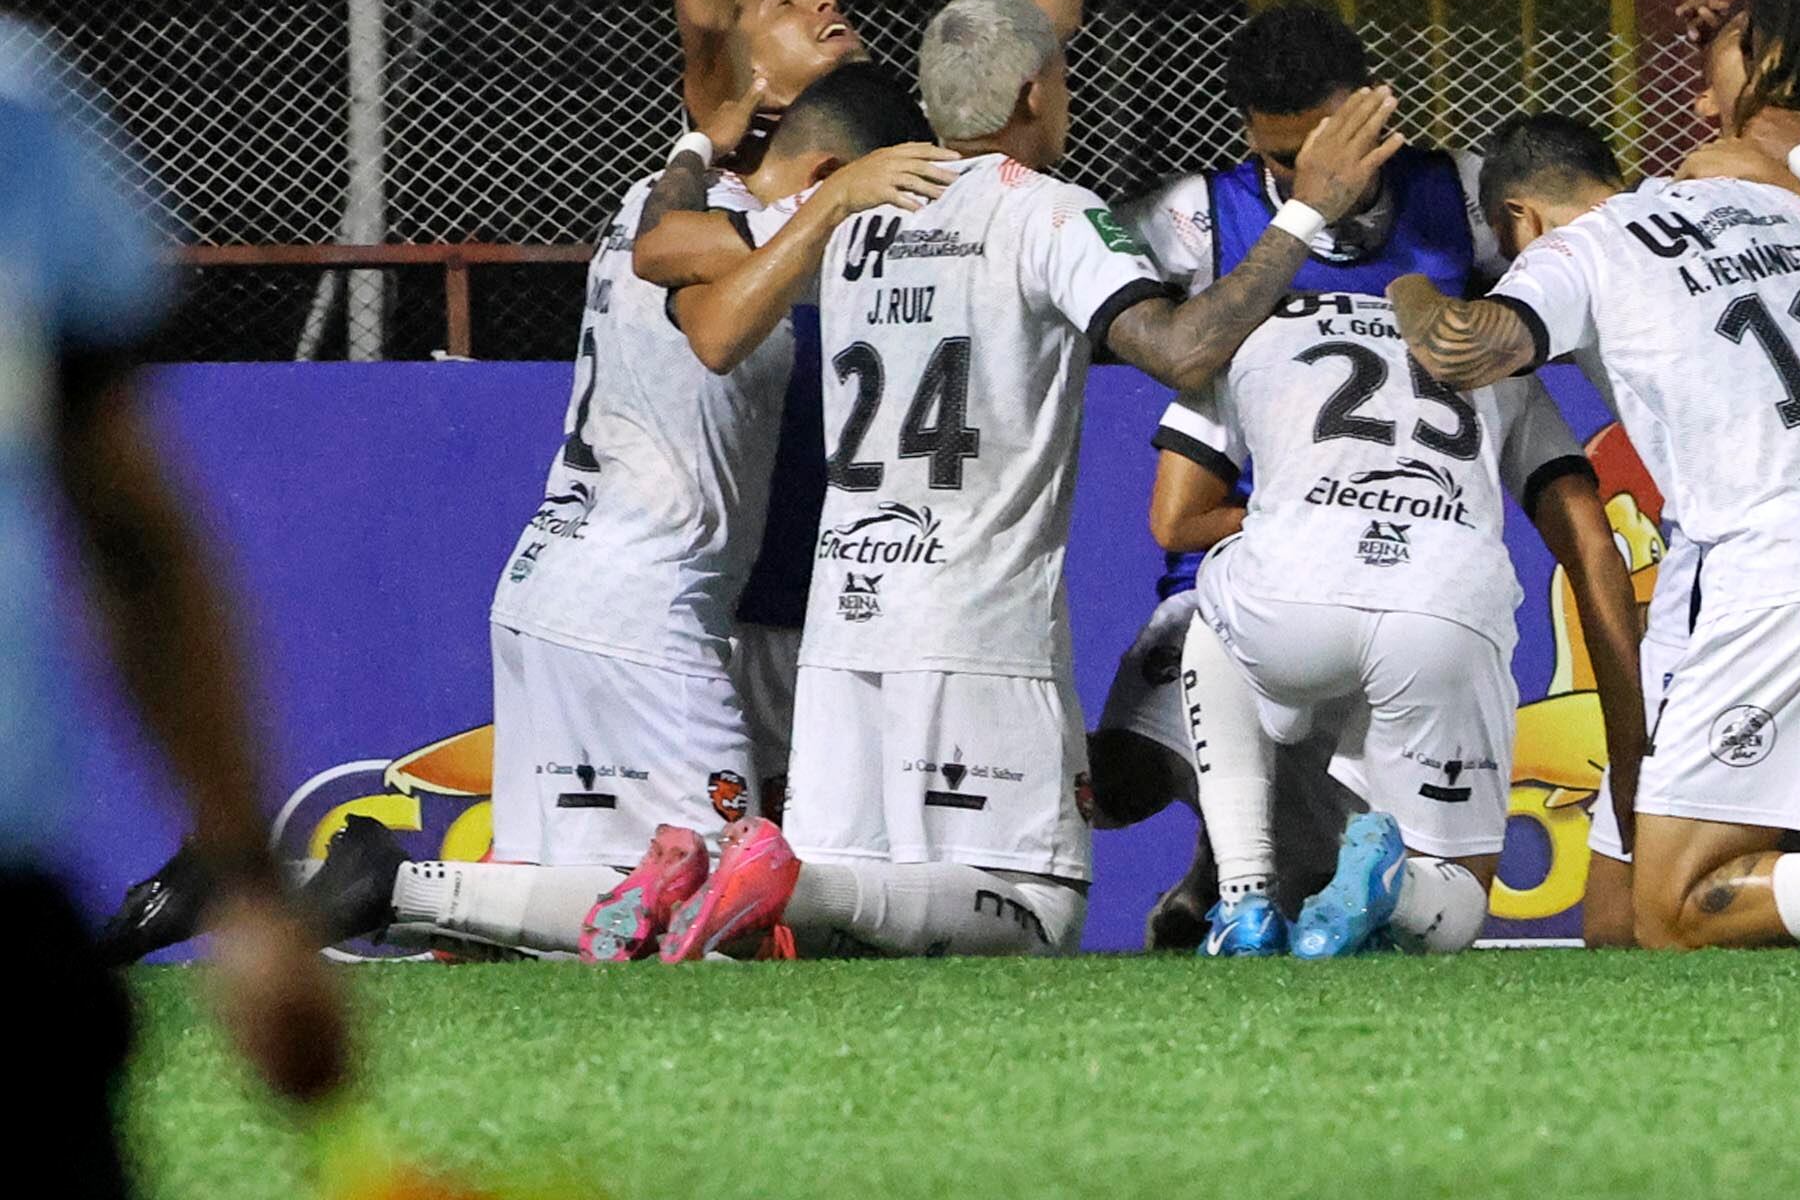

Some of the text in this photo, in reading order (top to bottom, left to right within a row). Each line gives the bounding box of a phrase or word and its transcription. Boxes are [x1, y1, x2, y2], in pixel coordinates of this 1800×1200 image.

[886, 286, 936, 324] RUIZ
[827, 336, 980, 492] 24
[1293, 341, 1482, 461] 25
[1304, 476, 1476, 530] Electrolit
